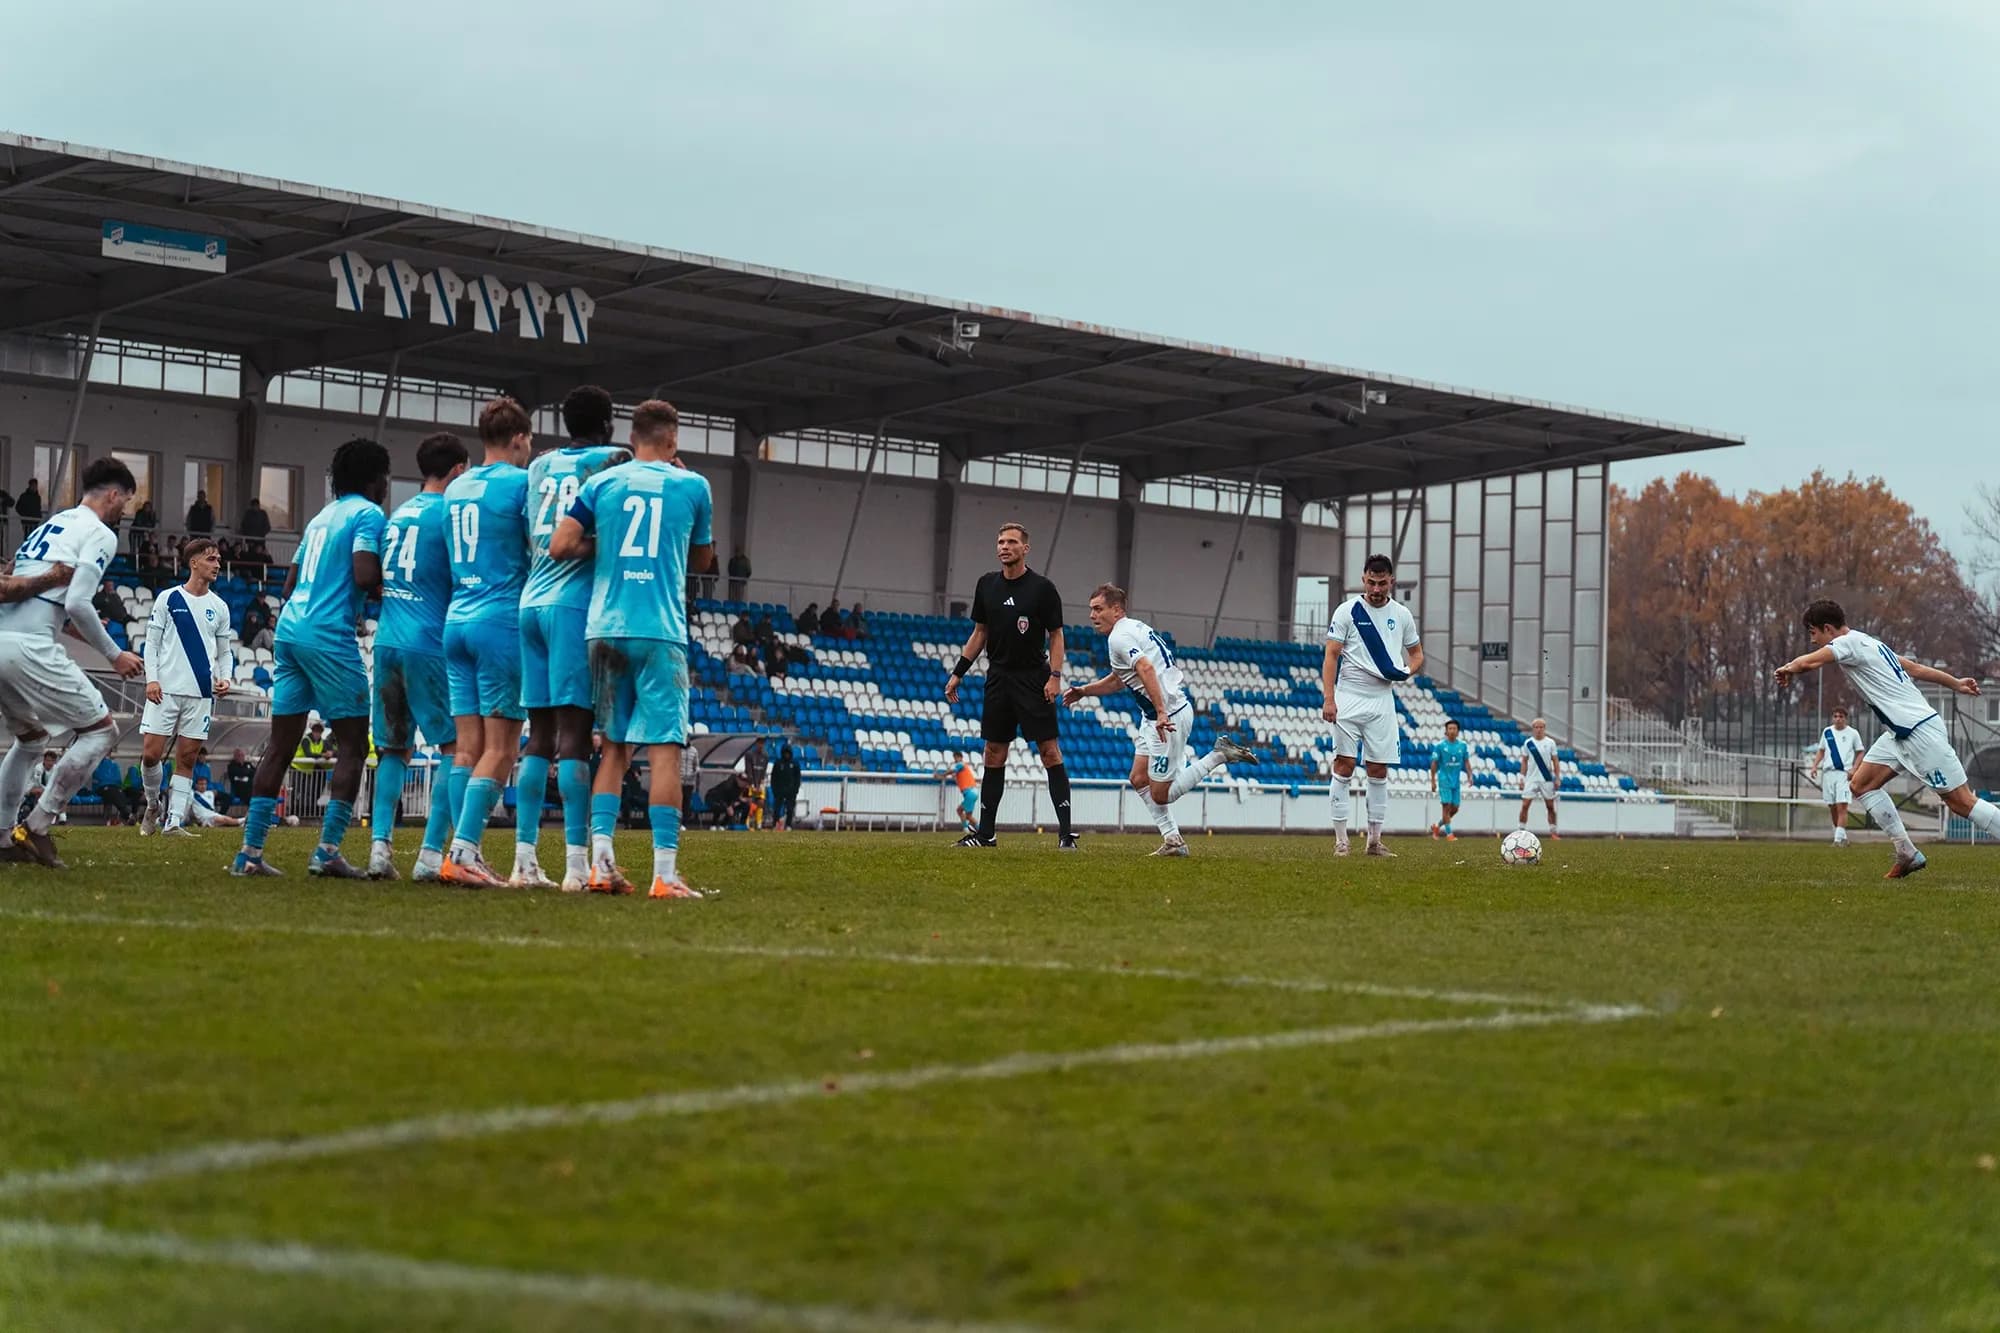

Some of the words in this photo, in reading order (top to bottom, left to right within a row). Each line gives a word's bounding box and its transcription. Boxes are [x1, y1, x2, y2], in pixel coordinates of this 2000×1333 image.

[450, 503, 479, 563] 19
[533, 475, 579, 535] 28
[619, 495, 663, 558] 21
[382, 524, 419, 582] 24
[1484, 643, 1507, 657] WC
[1925, 767, 1948, 789] 14
